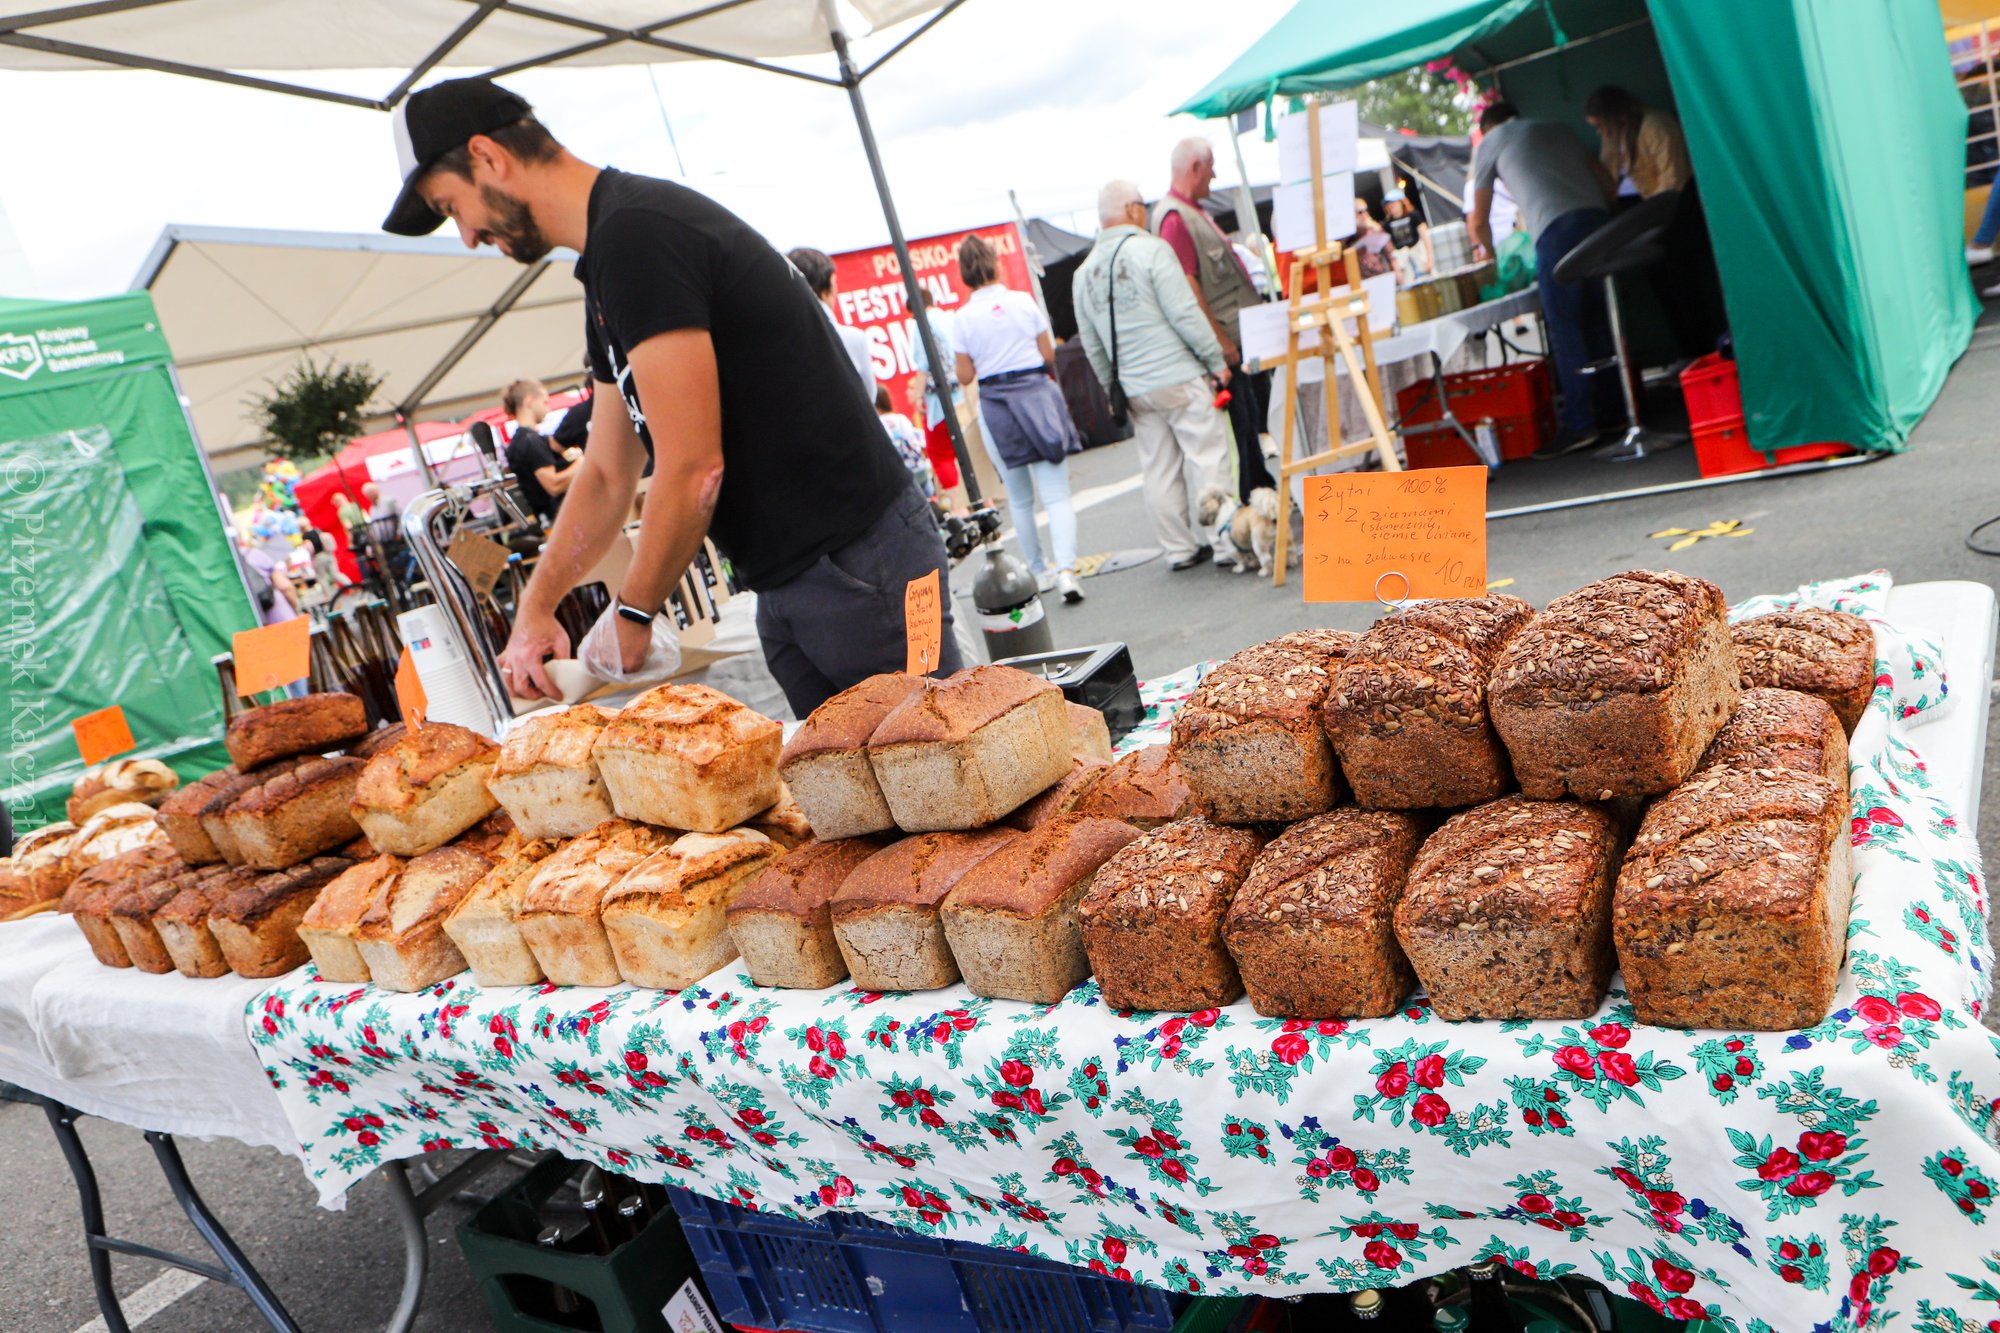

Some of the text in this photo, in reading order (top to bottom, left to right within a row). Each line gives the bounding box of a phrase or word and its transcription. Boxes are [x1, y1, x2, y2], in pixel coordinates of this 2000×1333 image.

[837, 273, 960, 326] FESTIAL
[1318, 475, 1448, 514] Żytni 100%
[1369, 502, 1455, 521] ziarnami
[1337, 555, 1353, 565] na
[1434, 557, 1485, 591] 10 PLN
